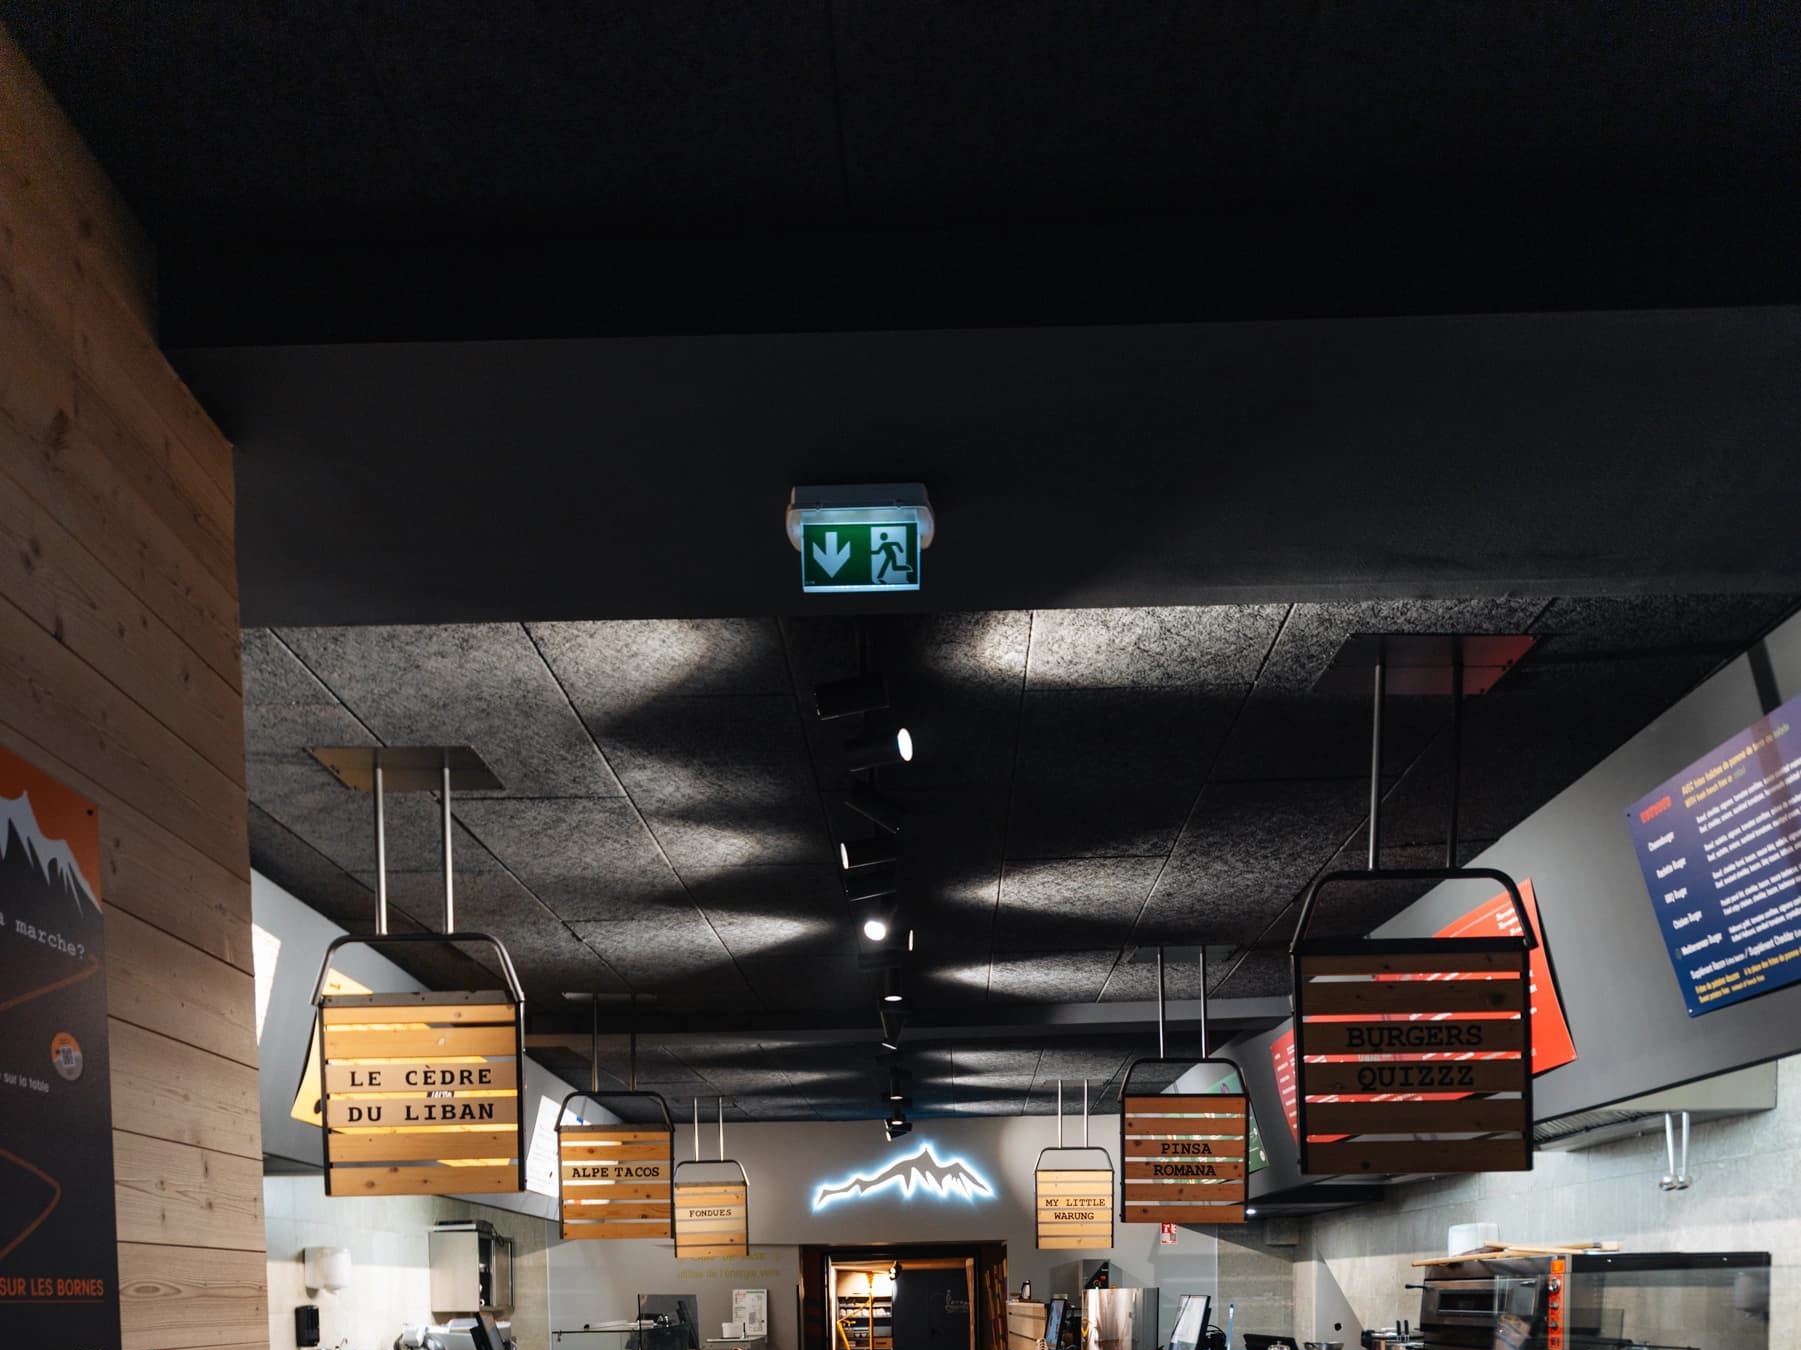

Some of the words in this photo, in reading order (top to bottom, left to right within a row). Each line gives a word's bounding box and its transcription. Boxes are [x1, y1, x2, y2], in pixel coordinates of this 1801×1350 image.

[15, 919, 85, 959] marche?
[1346, 1025, 1483, 1048] BURGERS
[350, 1071, 382, 1087] LE
[405, 1065, 492, 1086] CÈDRE
[1357, 1065, 1475, 1091] QUIZZZ
[348, 1106, 383, 1122] DU
[404, 1103, 494, 1121] LIBAN
[1161, 1143, 1212, 1154] PINSA
[572, 1167, 609, 1178] ALPE
[614, 1167, 660, 1177] TACOS
[1153, 1164, 1216, 1176] ROMANA
[1045, 1199, 1063, 1207] MY
[1066, 1198, 1106, 1207] LITTLE
[689, 1208, 732, 1218] FONDUES
[1054, 1212, 1094, 1220] WARUNG
[0, 1278, 26, 1296] SUR
[31, 1278, 53, 1296] LES
[57, 1279, 104, 1297] BORNES
